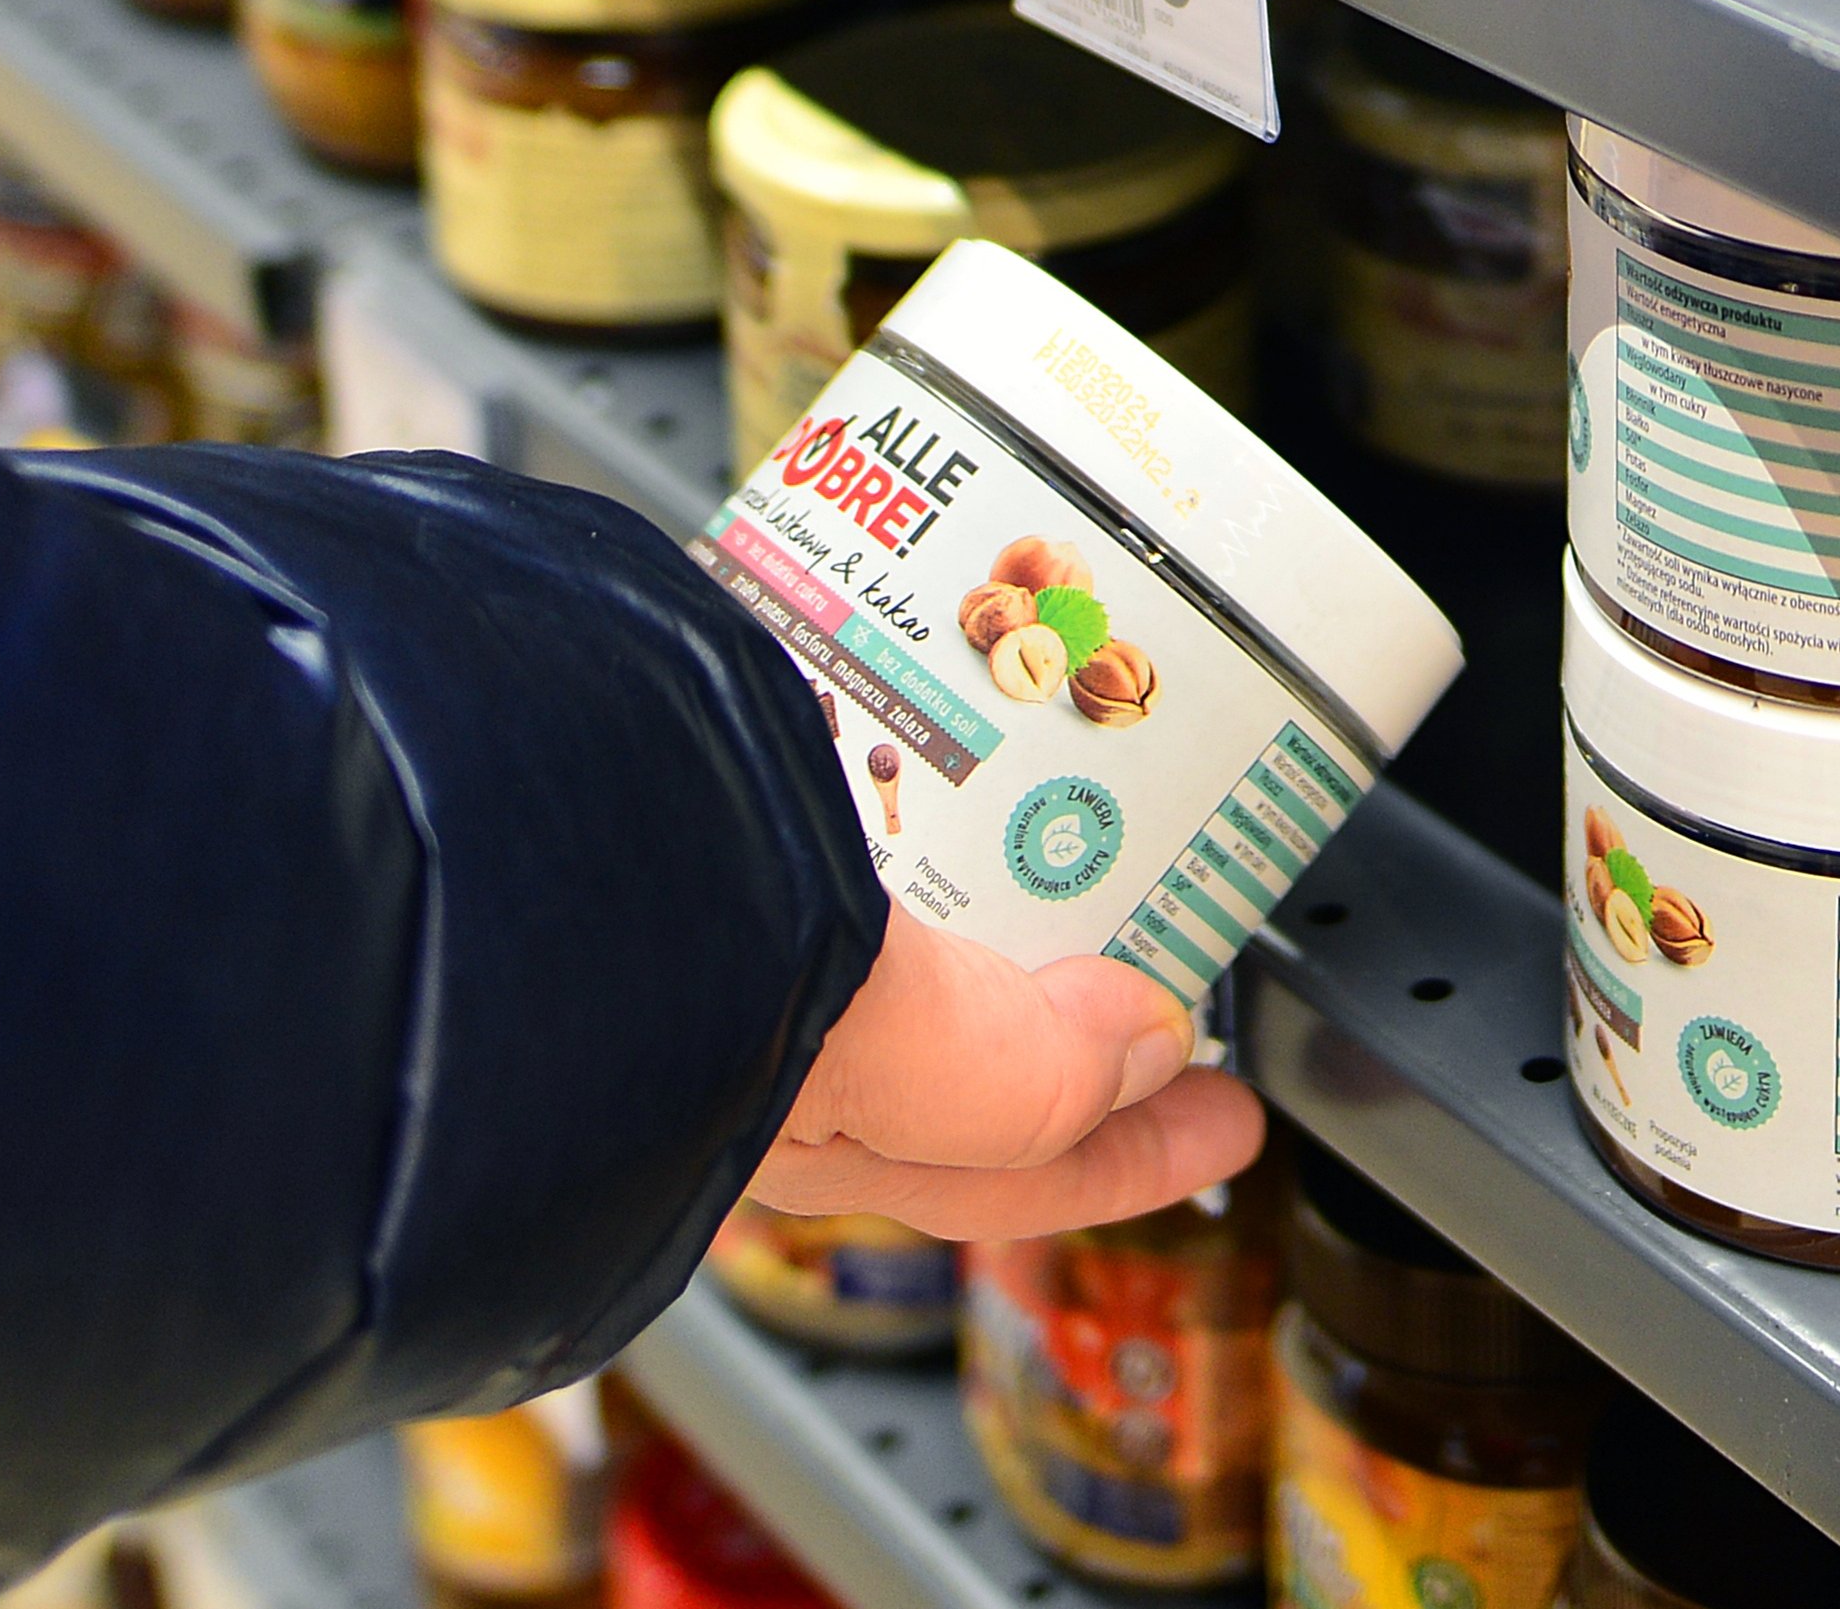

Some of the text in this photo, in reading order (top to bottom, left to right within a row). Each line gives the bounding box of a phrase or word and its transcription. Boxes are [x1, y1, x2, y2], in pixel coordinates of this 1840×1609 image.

[1660, 302, 1727, 339] energetyczna
[1664, 284, 1719, 316] odżywcza
[1721, 304, 1783, 332] produktu
[1651, 338, 1824, 405] tym kwasy tłuszczowe nasycone
[1658, 384, 1708, 420] tym cukry
[857, 405, 980, 508] ALLE
[1663, 555, 1681, 572] soli
[1682, 563, 1719, 587] wynika
[1721, 578, 1779, 606] wyłącznie
[1678, 577, 1706, 599] sodu.
[857, 572, 931, 643] kakao
[1660, 587, 1721, 624] referencyjne
[1722, 613, 1771, 639] wartości
[1773, 626, 1825, 651] spożycia
[1686, 617, 1711, 636] osób
[1712, 622, 1775, 657] dorosłych).
[875, 647, 979, 739] bez dodatku soli
[887, 706, 931, 747] żelaza
[1066, 785, 1115, 832] ZAWIERA
[915, 855, 971, 910] Propozycja
[1074, 848, 1110, 886] cukry
[905, 880, 951, 922] podania
